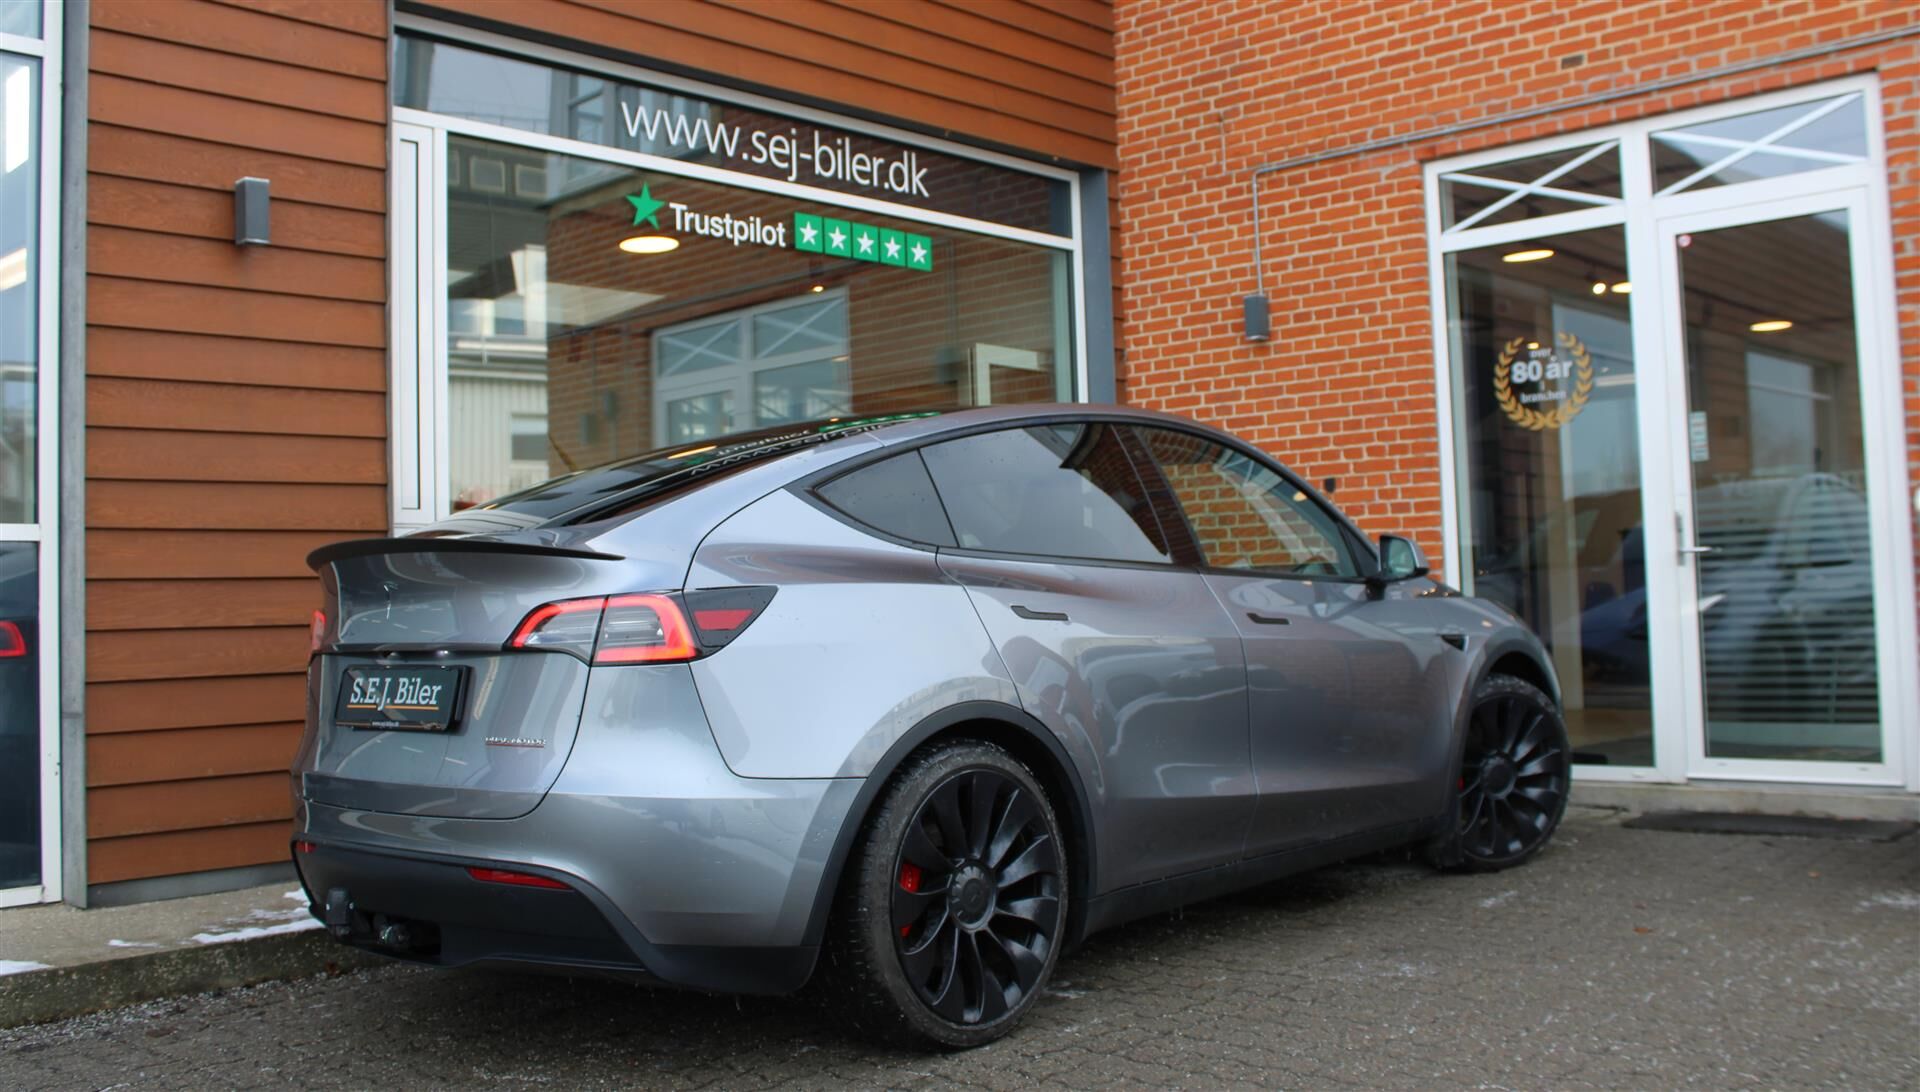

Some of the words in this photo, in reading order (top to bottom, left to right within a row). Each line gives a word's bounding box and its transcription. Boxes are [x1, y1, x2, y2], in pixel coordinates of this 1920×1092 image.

[621, 101, 930, 198] www.sej-biler.dk
[669, 202, 786, 248] Trustpilot
[1511, 360, 1543, 384] 80
[1545, 355, 1574, 380] år
[350, 677, 392, 711] S.E.J.
[394, 677, 442, 705] Biler
